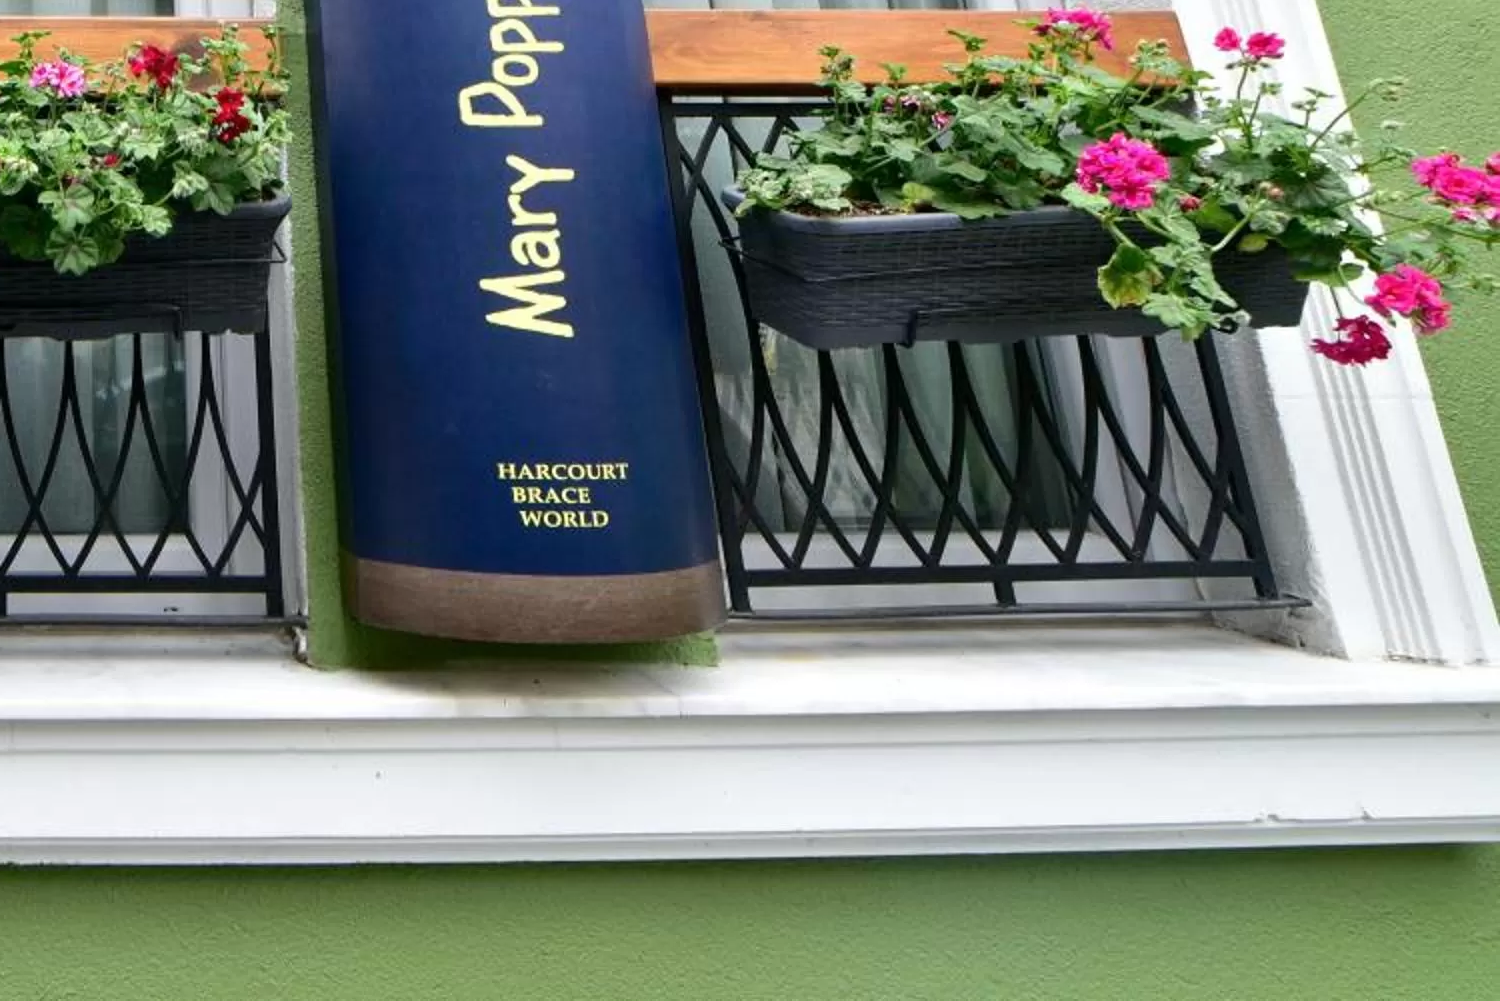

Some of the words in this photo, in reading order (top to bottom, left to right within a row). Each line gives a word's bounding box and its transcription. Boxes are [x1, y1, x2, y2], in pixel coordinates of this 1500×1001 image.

[479, 154, 575, 339] Mary
[496, 462, 630, 481] HARCOURT
[512, 486, 592, 504] BRACE
[519, 510, 610, 528] WORLD
